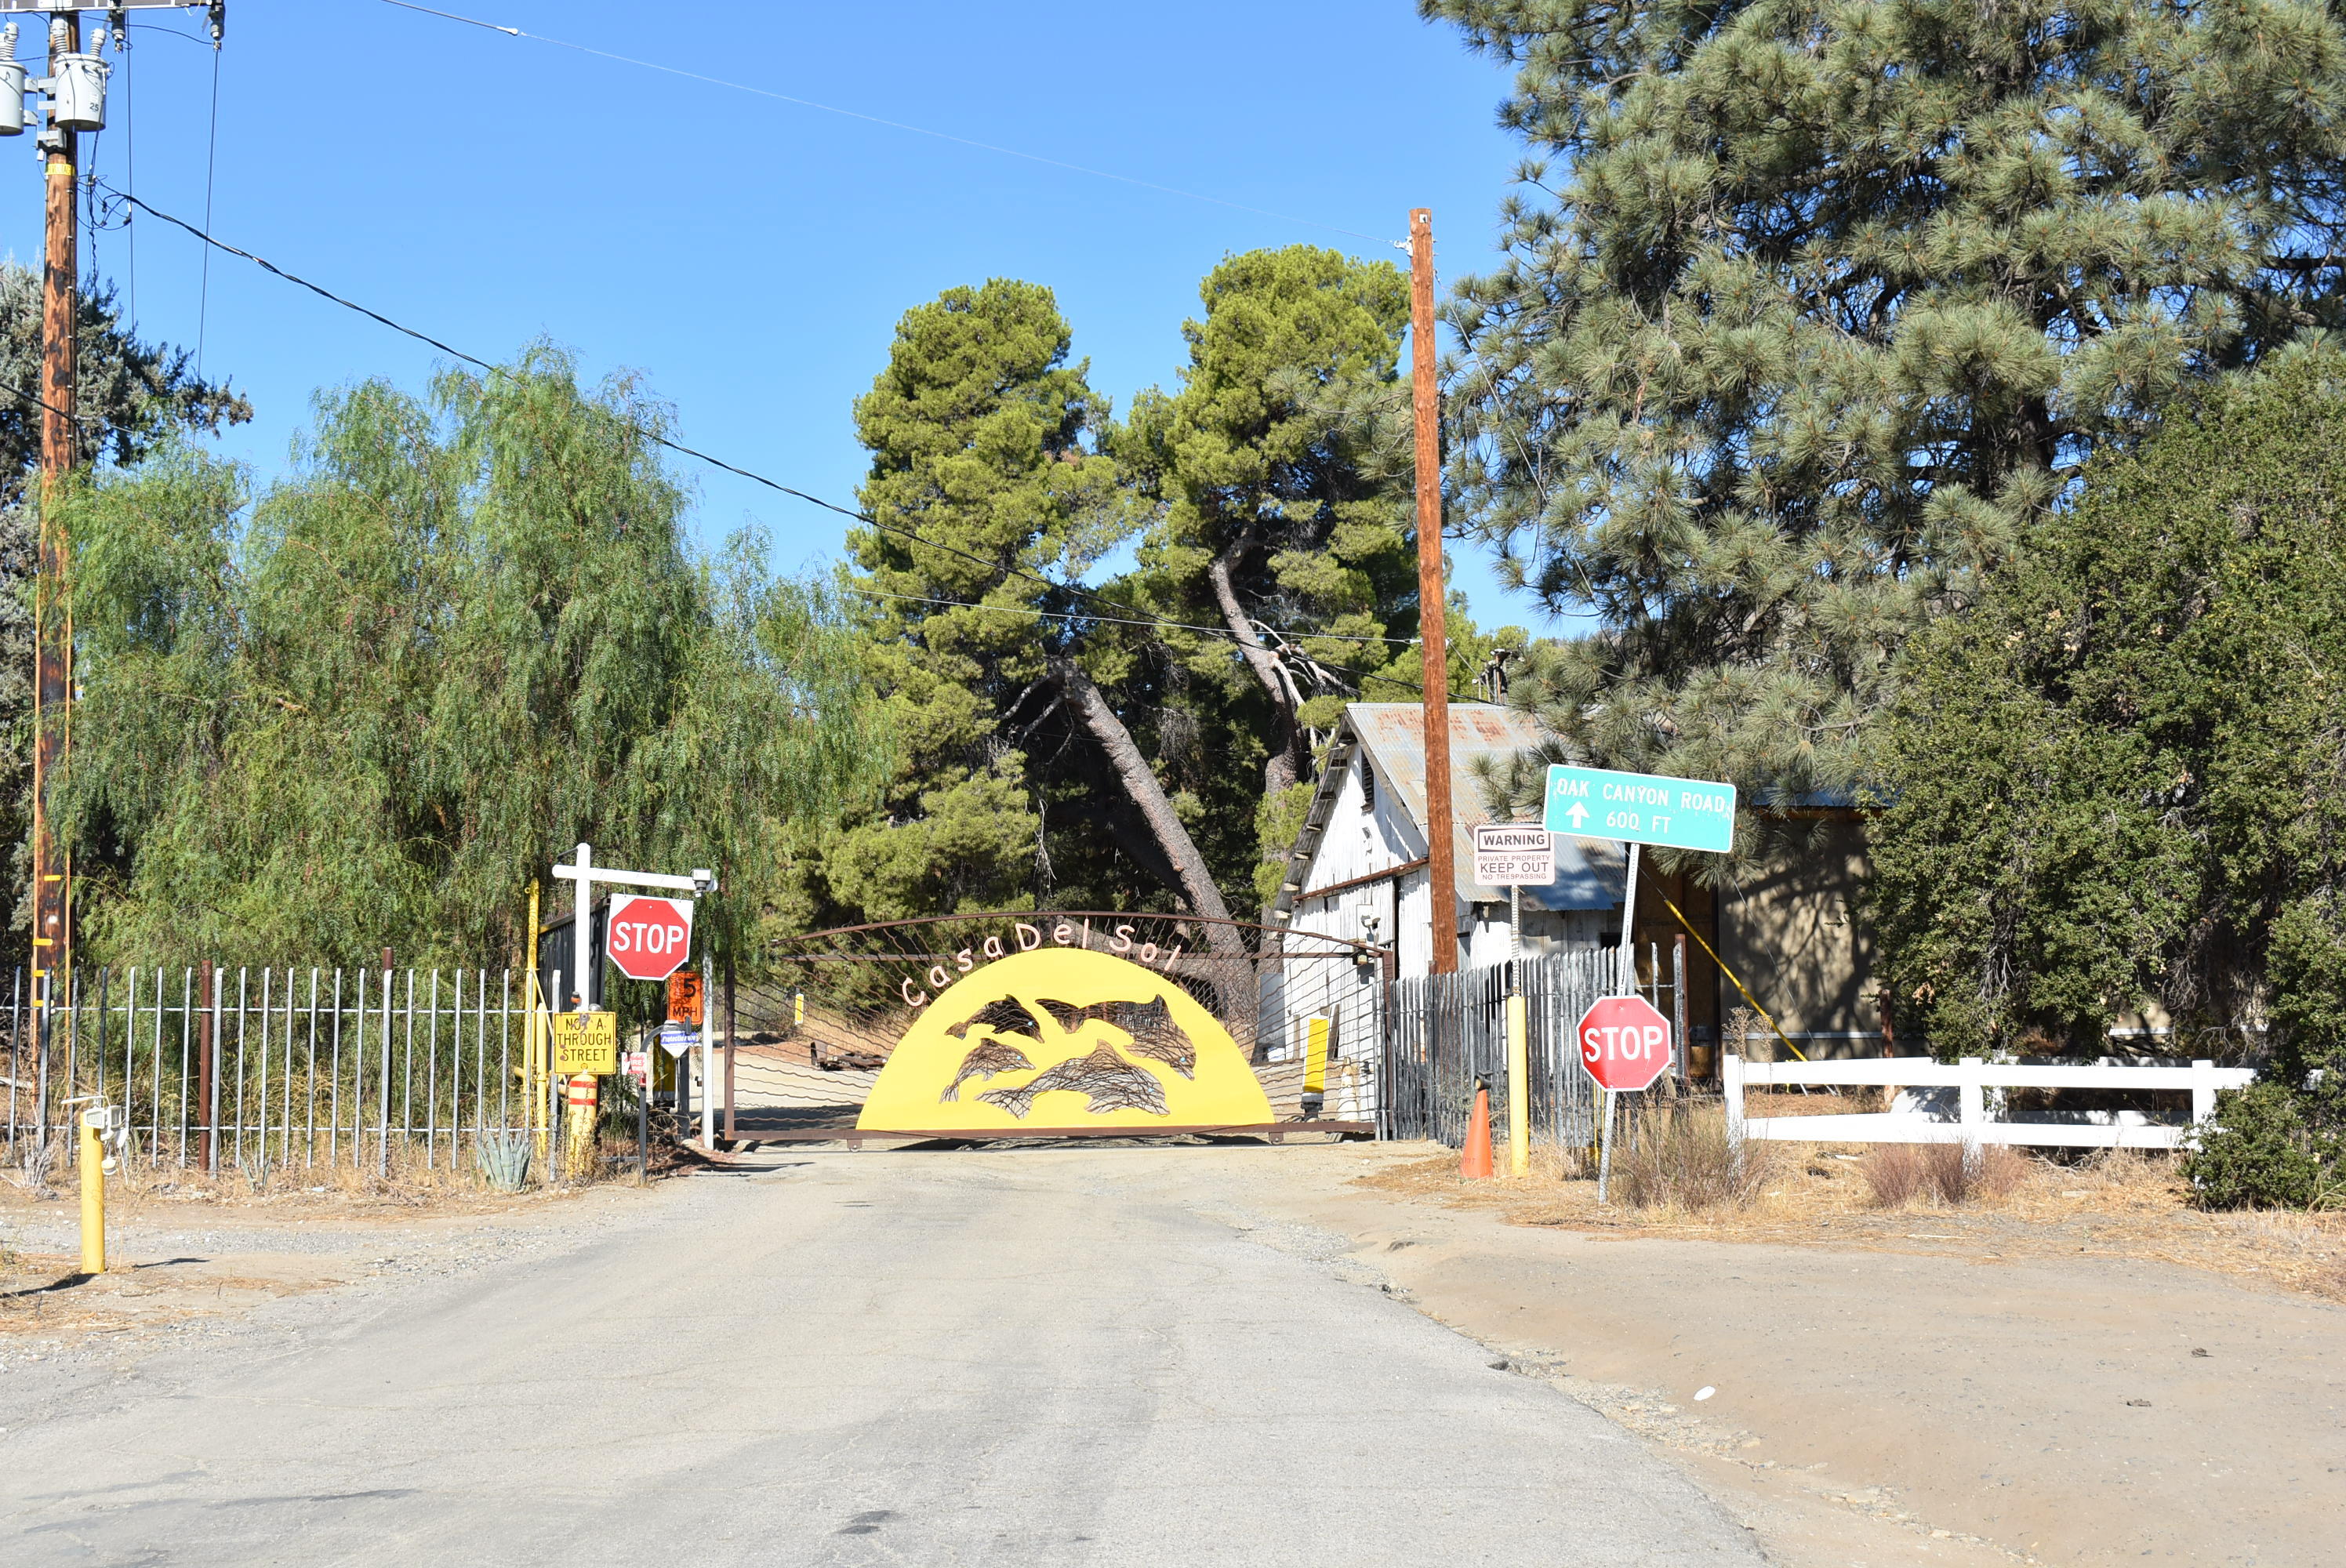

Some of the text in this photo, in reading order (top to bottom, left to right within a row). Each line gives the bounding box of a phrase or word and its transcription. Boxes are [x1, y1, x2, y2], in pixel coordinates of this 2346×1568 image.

[89, 102, 100, 112] 25
[1556, 778, 1726, 813] OAK CANYON ROAD
[1606, 811, 1672, 834] 600 FT
[1484, 834, 1545, 846] WARNING
[1480, 862, 1549, 873] KEEP OUT
[613, 921, 685, 954] STOP
[901, 918, 1182, 1007] Casa Del Sol
[684, 977, 697, 998] 5
[672, 1006, 698, 1017] MPH
[565, 1018, 604, 1029] NO A
[557, 1033, 612, 1046] THROUGH
[1584, 1025, 1663, 1062] STOP
[562, 1048, 608, 1062] STREET
